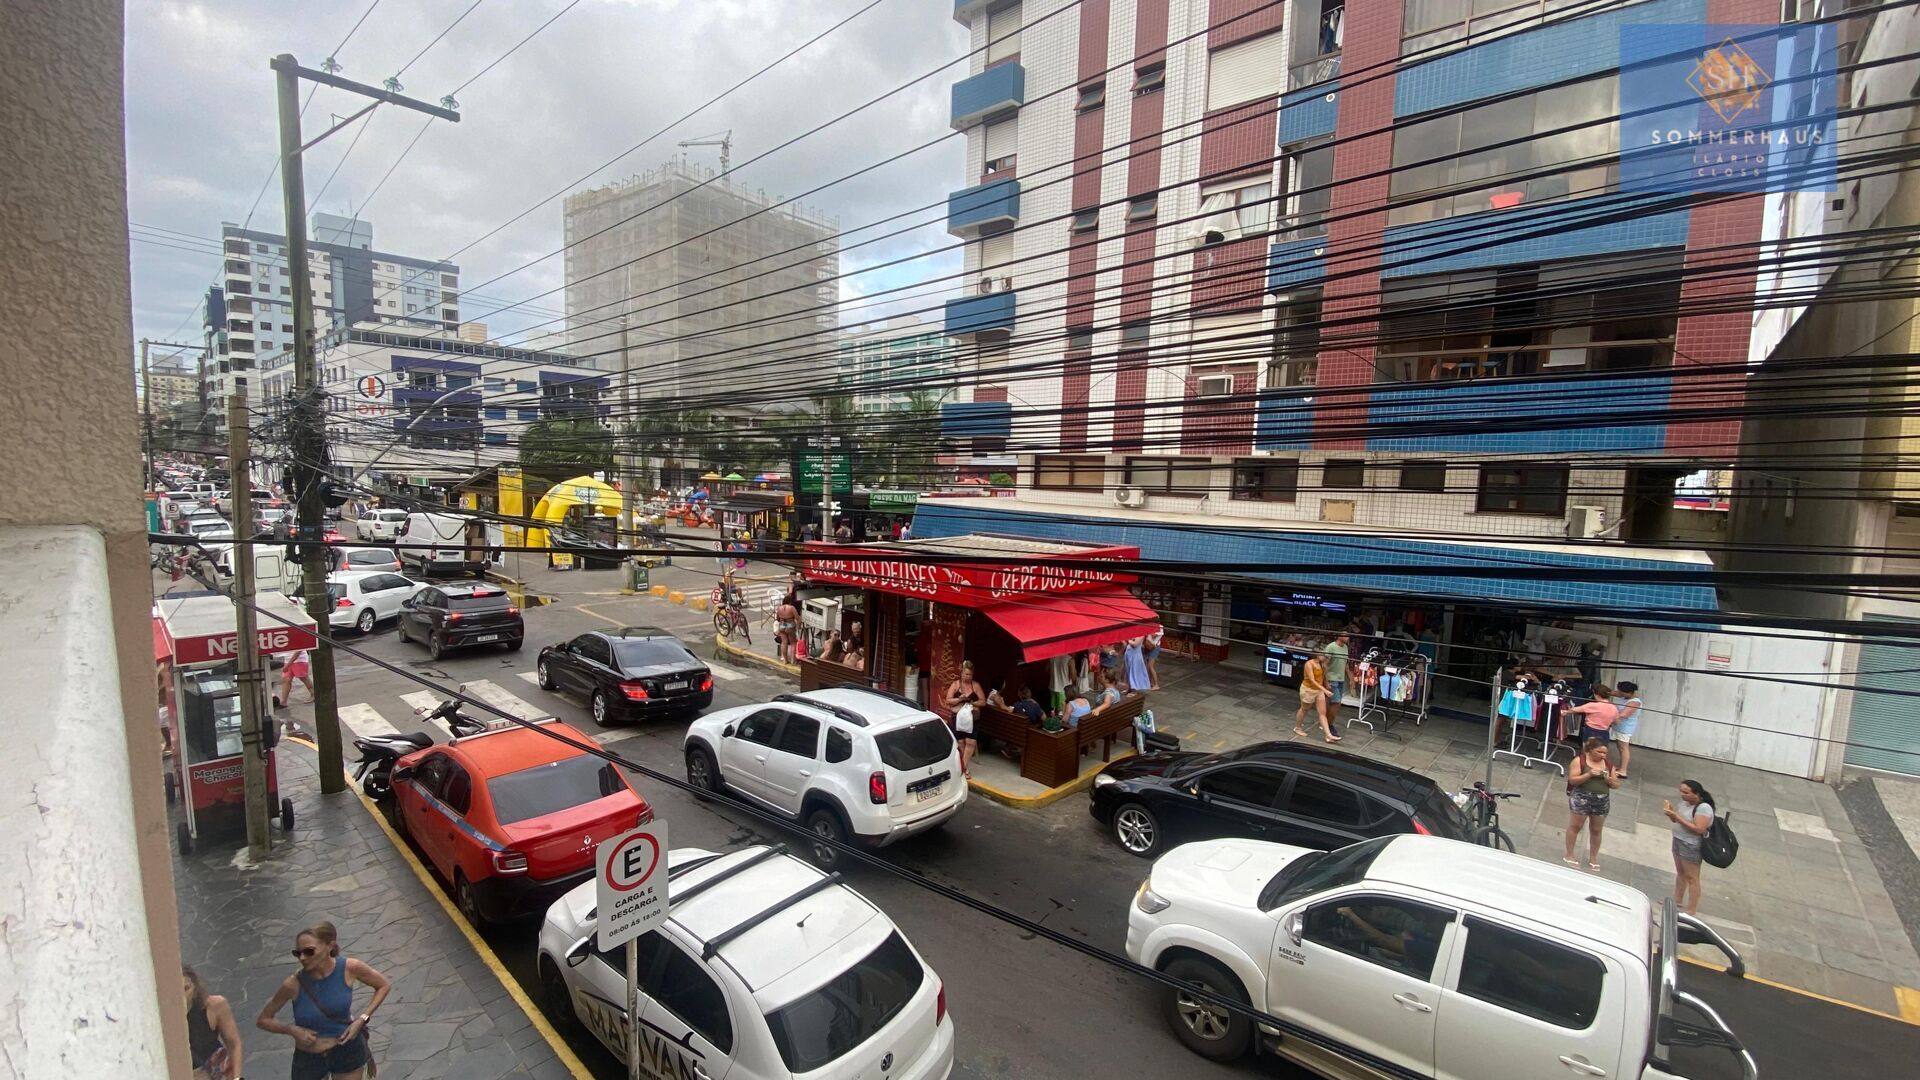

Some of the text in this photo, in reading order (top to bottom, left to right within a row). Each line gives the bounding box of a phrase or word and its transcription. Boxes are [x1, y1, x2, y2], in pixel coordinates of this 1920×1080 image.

[851, 560, 878, 585] DOS
[880, 560, 938, 595] DEUSES
[1041, 565, 1067, 591] DOS
[207, 630, 289, 657] Netlé
[623, 844, 642, 880] E
[610, 895, 658, 922] DESCARGA
[614, 886, 654, 909] CARGA E
[608, 924, 629, 938] 08:00
